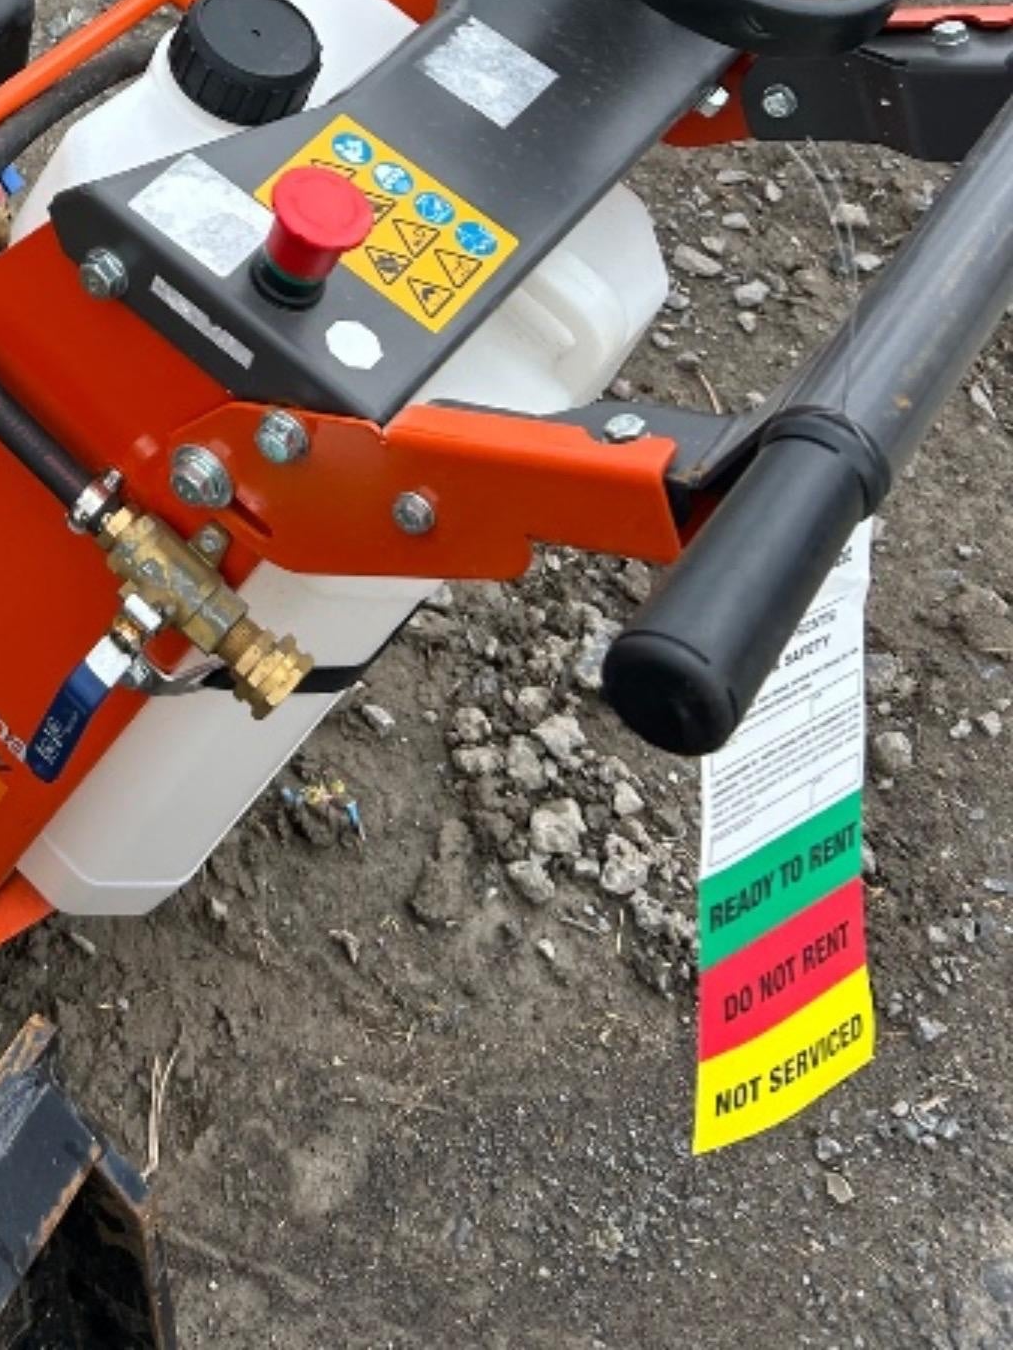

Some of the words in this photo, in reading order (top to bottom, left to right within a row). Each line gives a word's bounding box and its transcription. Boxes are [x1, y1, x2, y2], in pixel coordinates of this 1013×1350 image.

[710, 869, 776, 934] READY
[780, 853, 803, 889] TO
[809, 821, 858, 874] RENT
[724, 986, 753, 1024] DO
[759, 957, 797, 1000] NOT
[802, 921, 850, 971] RENT
[714, 1075, 762, 1117] NOT
[768, 1013, 864, 1094] SERVICED
